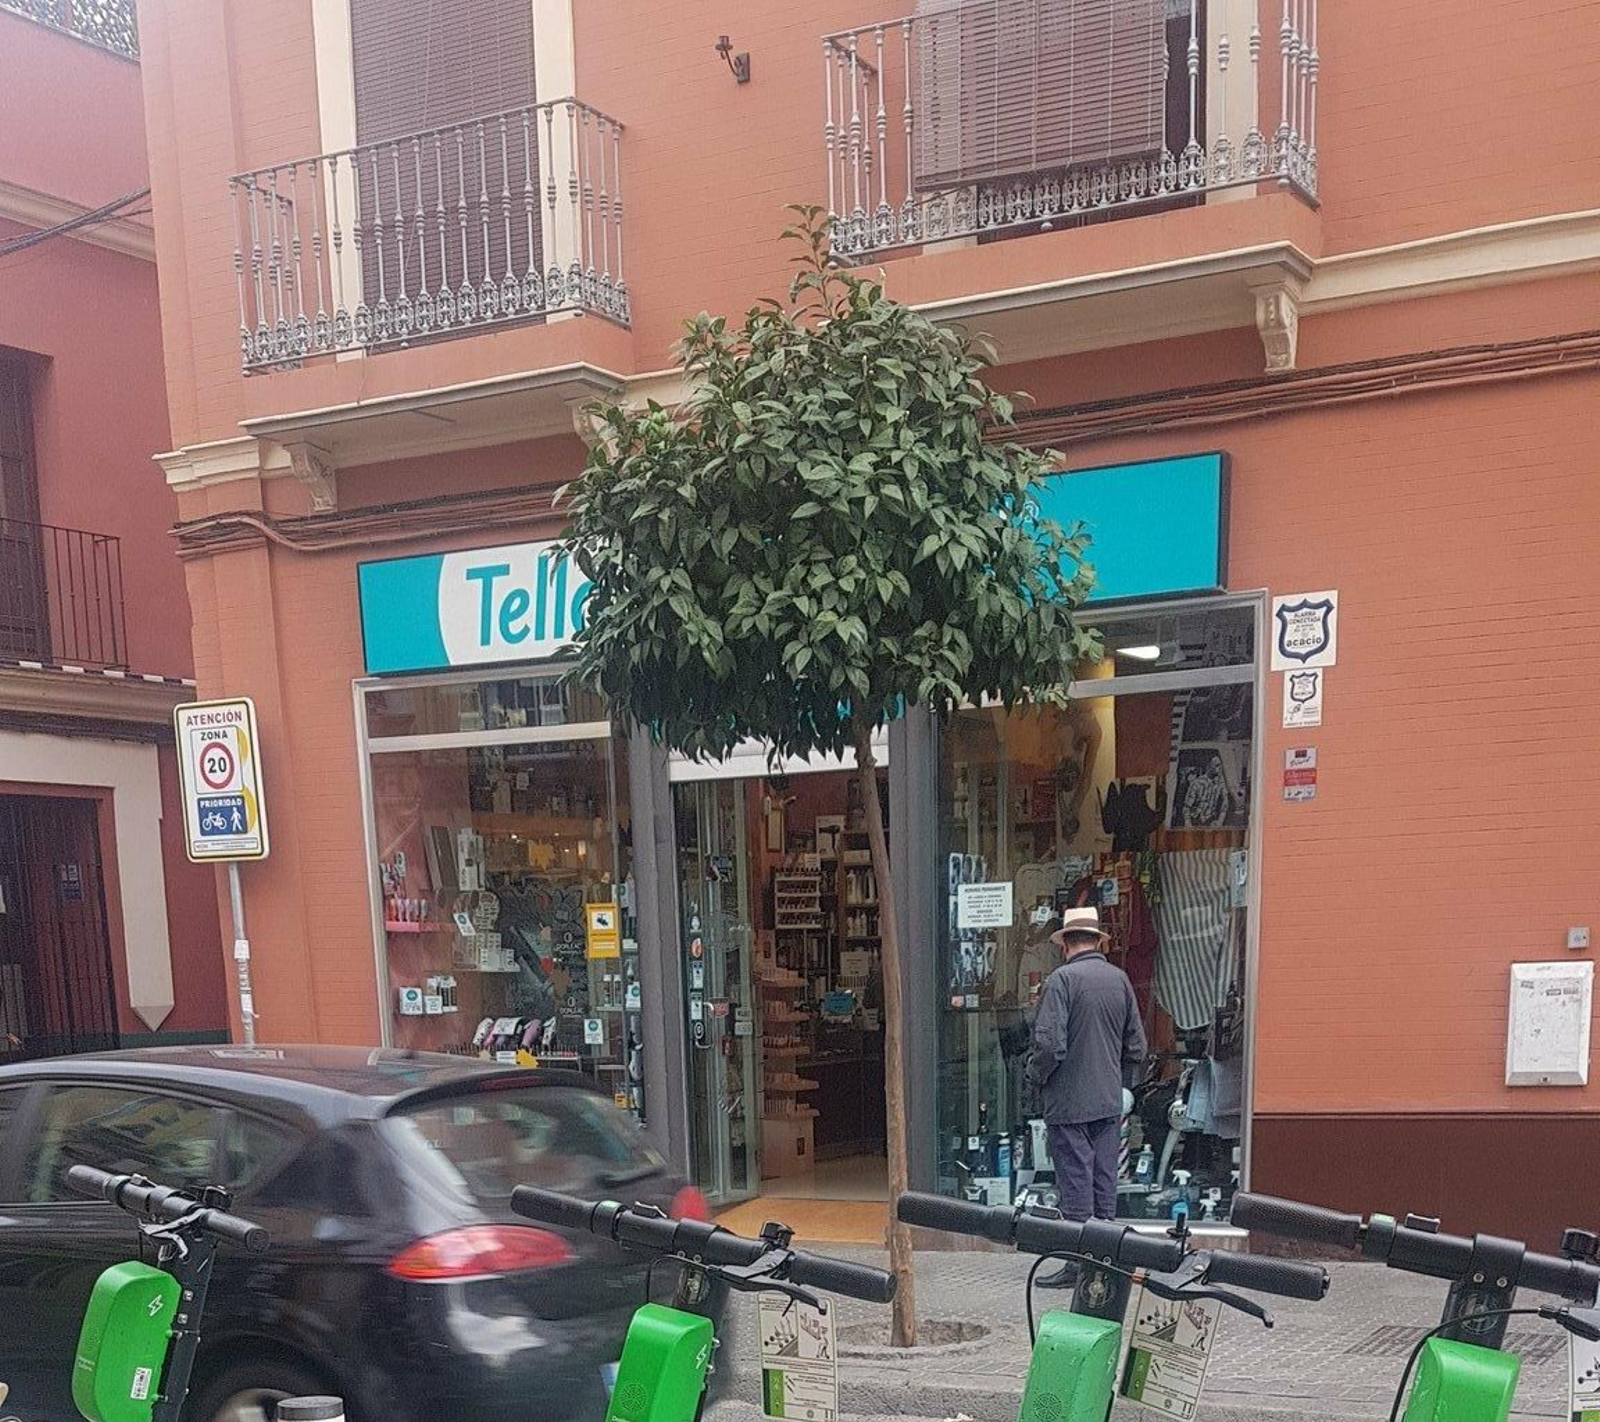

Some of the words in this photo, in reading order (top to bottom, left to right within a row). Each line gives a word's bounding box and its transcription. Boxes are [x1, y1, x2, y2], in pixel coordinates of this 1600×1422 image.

[1286, 635, 1323, 648] acacio
[186, 709, 242, 726] ATENCIÓN
[200, 730, 228, 741] ZONA
[207, 757, 227, 774] 20
[200, 798, 243, 809] PRIORIDAD
